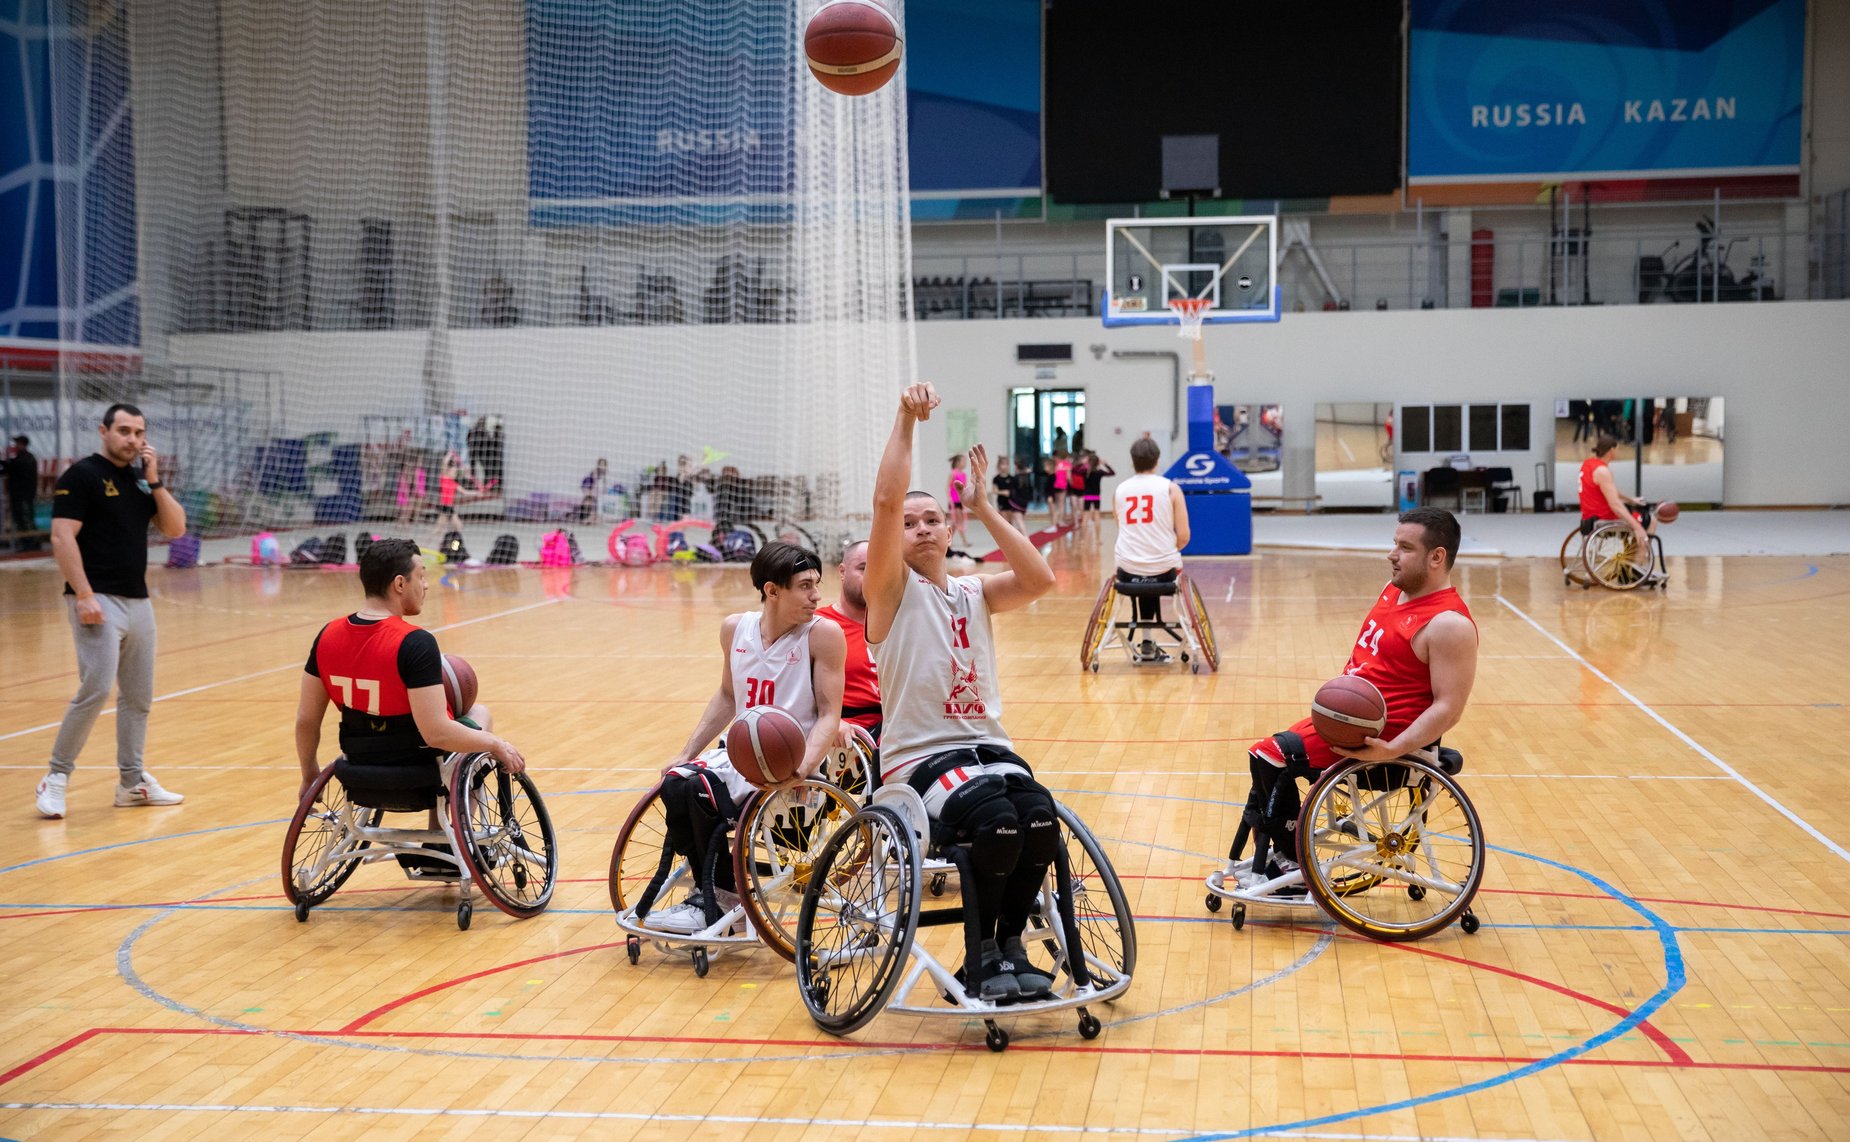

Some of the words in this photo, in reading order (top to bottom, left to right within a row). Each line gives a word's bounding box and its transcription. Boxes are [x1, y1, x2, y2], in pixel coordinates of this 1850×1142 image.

[1472, 103, 1586, 128] RUSSIA
[1624, 97, 1736, 123] KAZAN
[1126, 495, 1153, 524] 23
[1358, 619, 1384, 656] 24
[329, 675, 380, 716] 77
[746, 677, 774, 708] 30
[838, 752, 846, 769] 9
